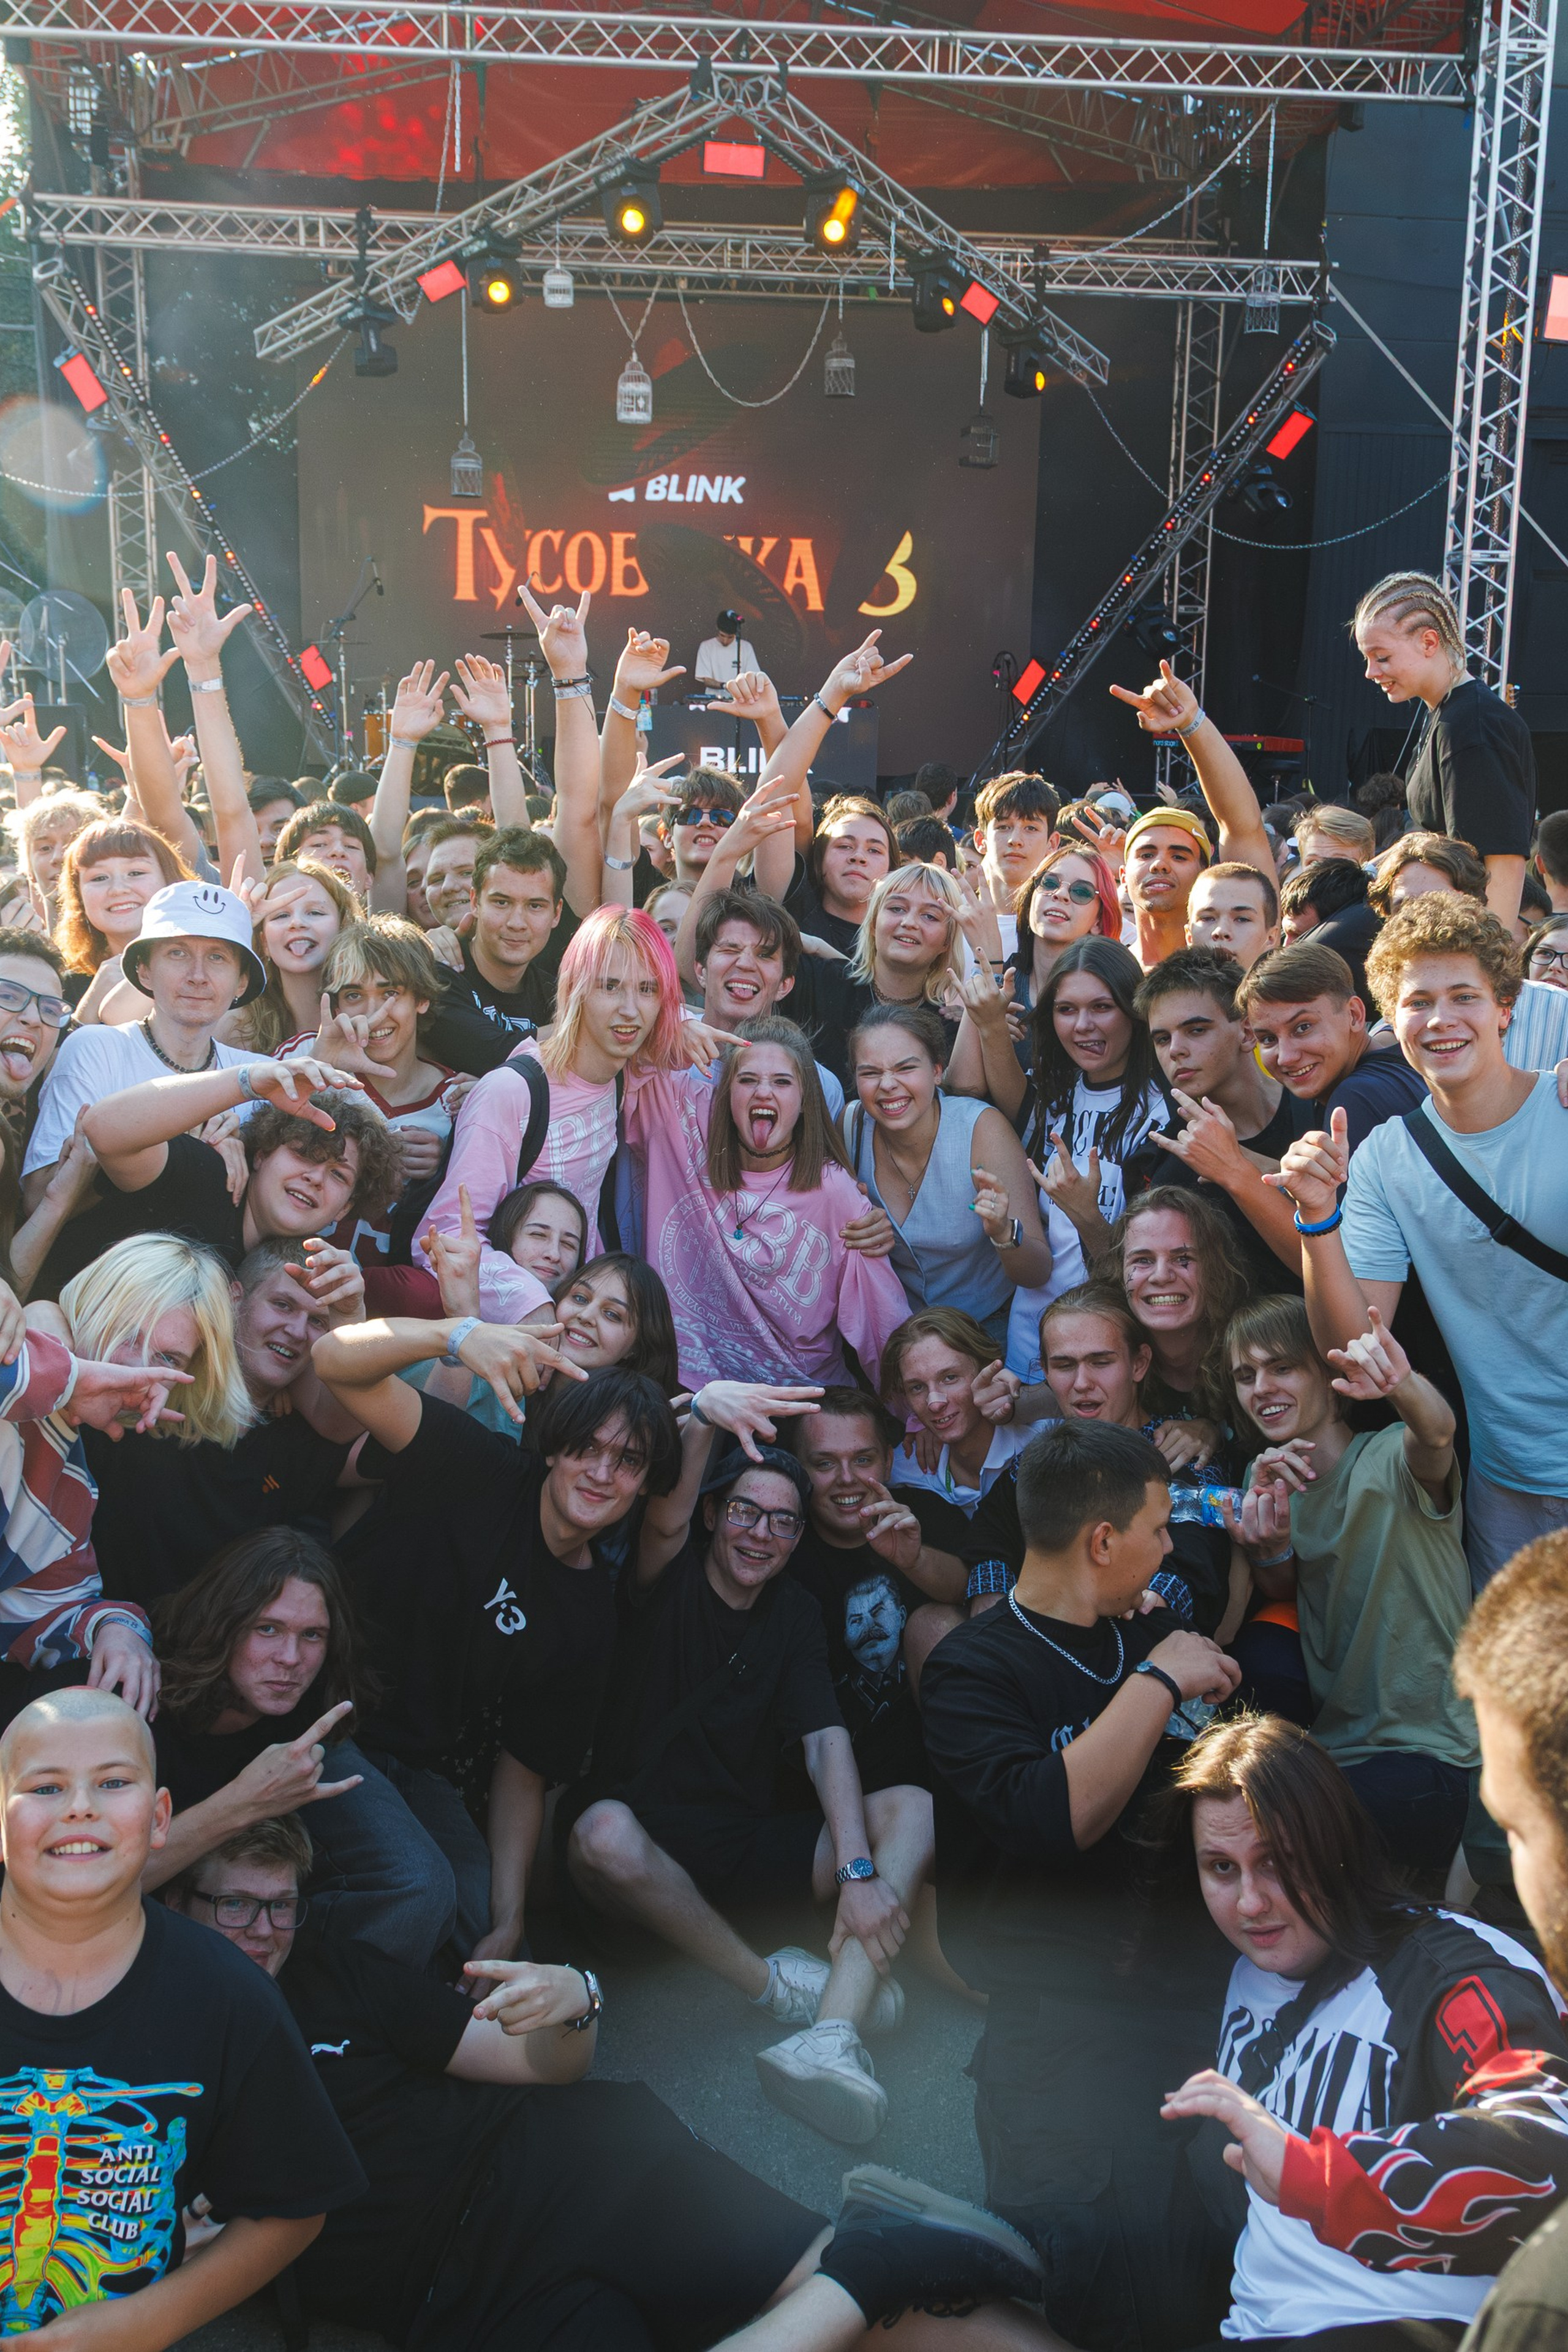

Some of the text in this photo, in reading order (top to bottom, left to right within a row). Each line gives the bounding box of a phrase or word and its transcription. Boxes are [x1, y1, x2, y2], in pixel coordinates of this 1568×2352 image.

[645, 473, 746, 504] BLINK
[99, 2144, 154, 2163] ANTI
[80, 2165, 160, 2185] SOCIAL
[77, 2189, 153, 2213] SOCIAL
[88, 2212, 138, 2240] CLUB
